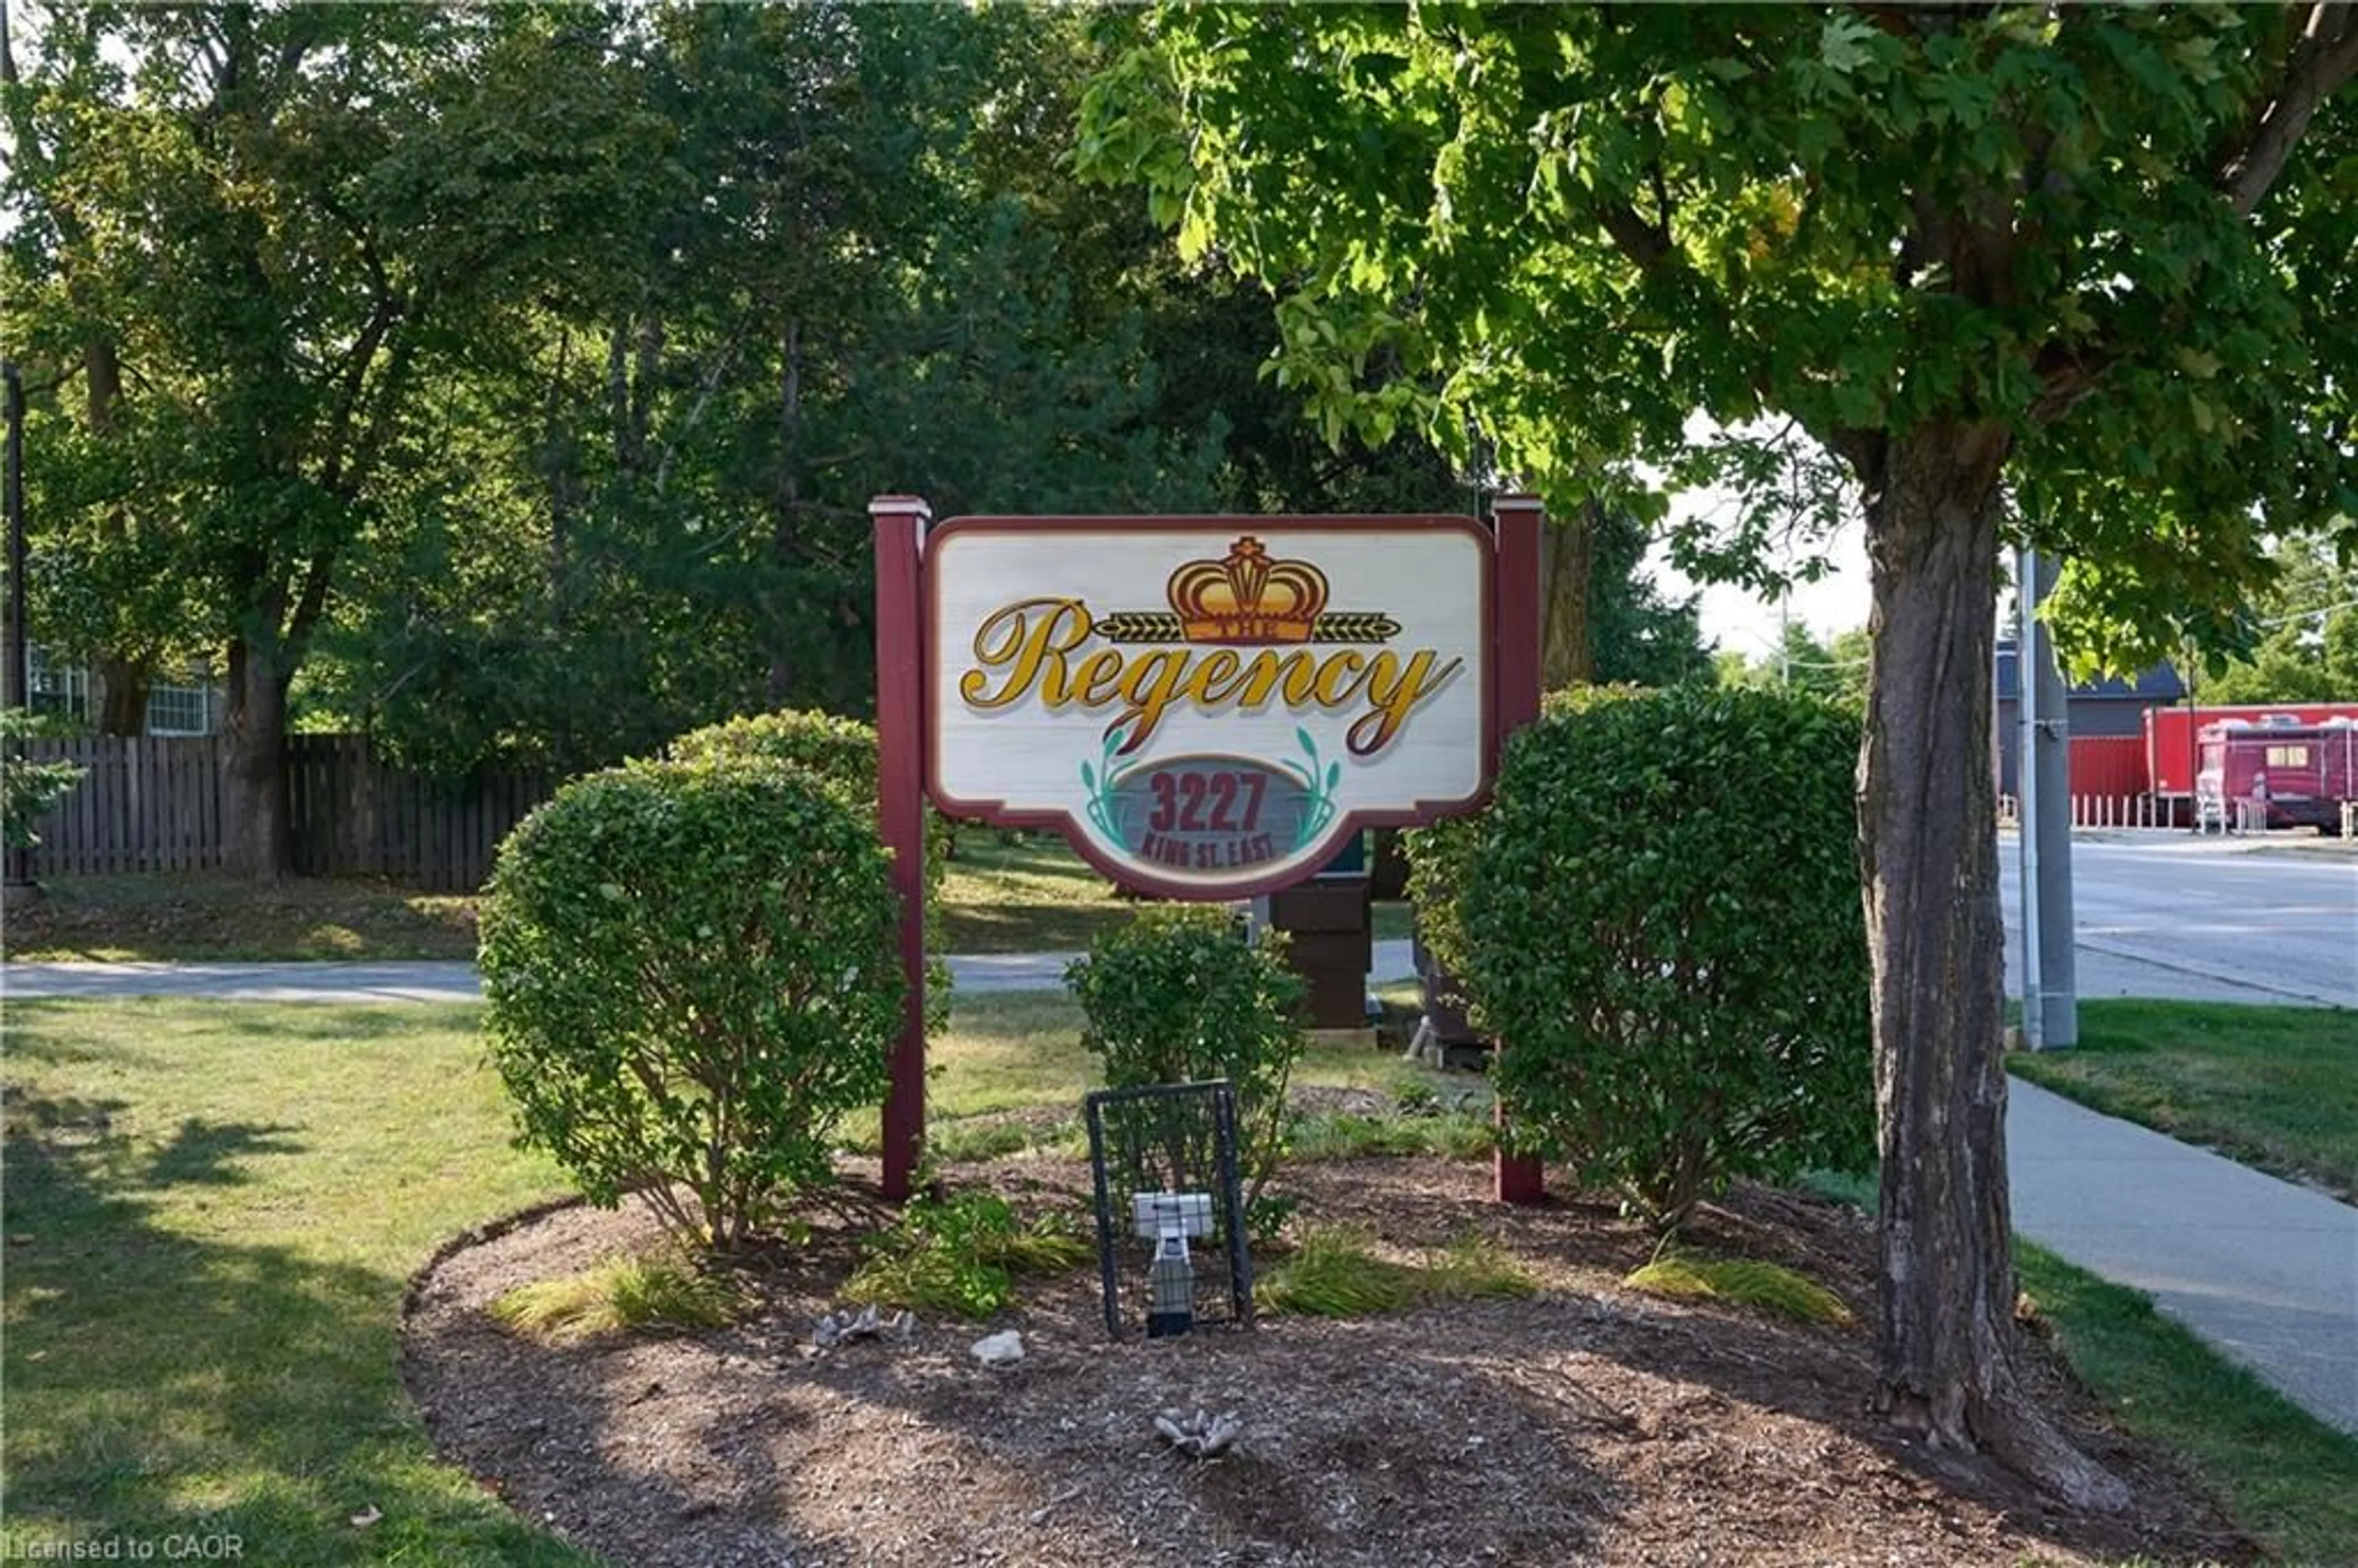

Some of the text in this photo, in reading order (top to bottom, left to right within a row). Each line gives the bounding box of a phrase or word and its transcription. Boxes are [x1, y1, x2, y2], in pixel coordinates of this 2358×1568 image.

[1215, 619, 1280, 639] THE
[960, 597, 1464, 756] Regency
[1150, 772, 1267, 832] 3227
[1142, 831, 1189, 866] KING
[1228, 831, 1273, 866] EAST
